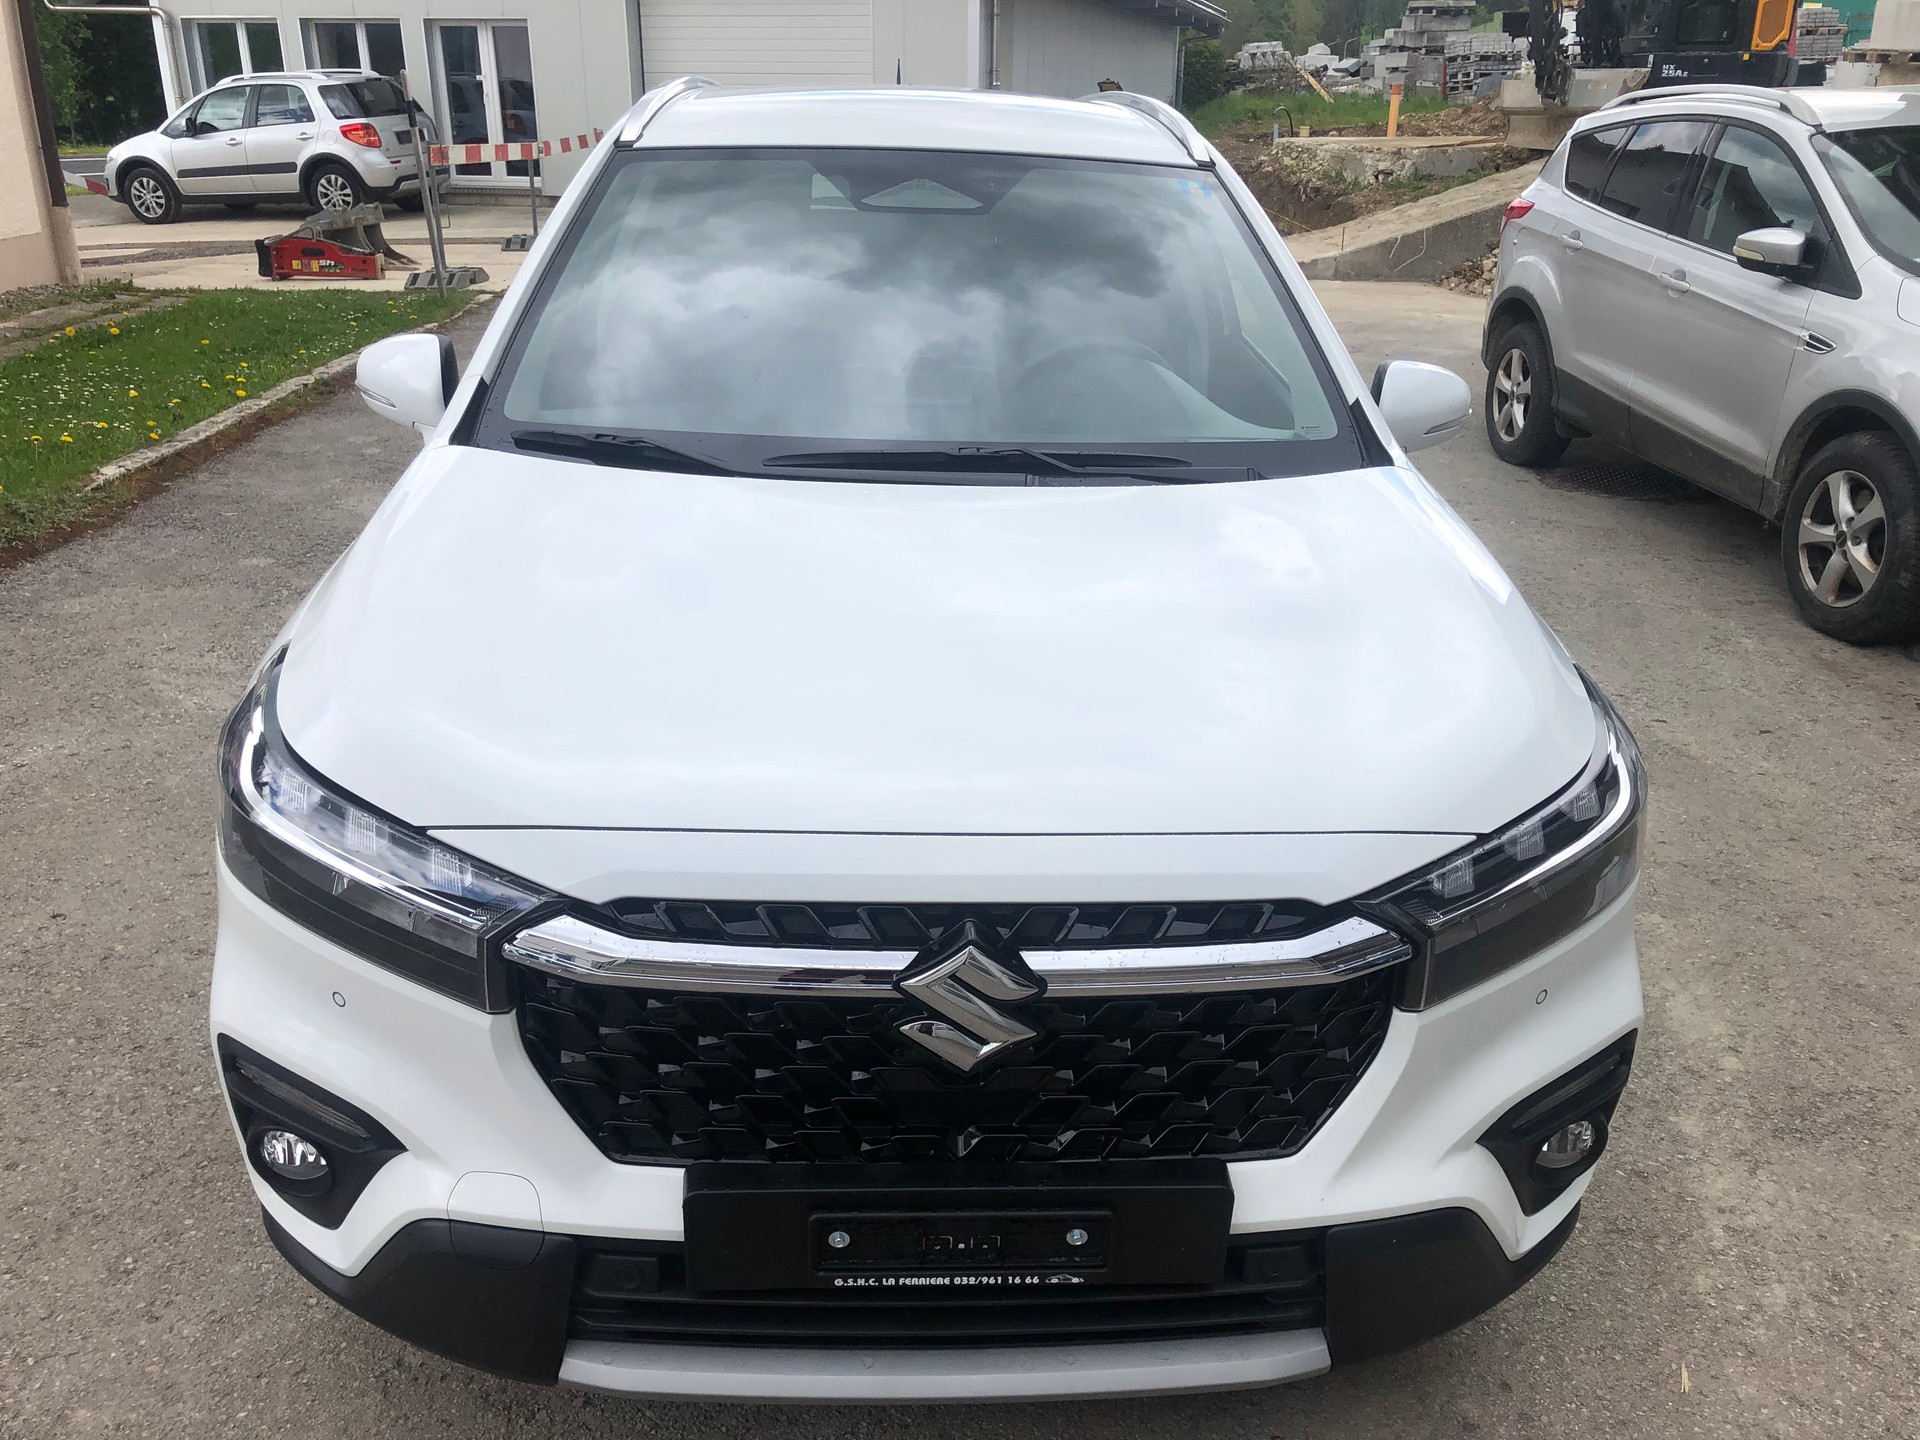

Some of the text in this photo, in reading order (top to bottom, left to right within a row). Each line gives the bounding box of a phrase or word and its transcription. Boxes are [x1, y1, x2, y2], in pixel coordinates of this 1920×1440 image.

[834, 1275, 1040, 1287] G.S.H.C. LA FERRIERE 032/961 16 66
